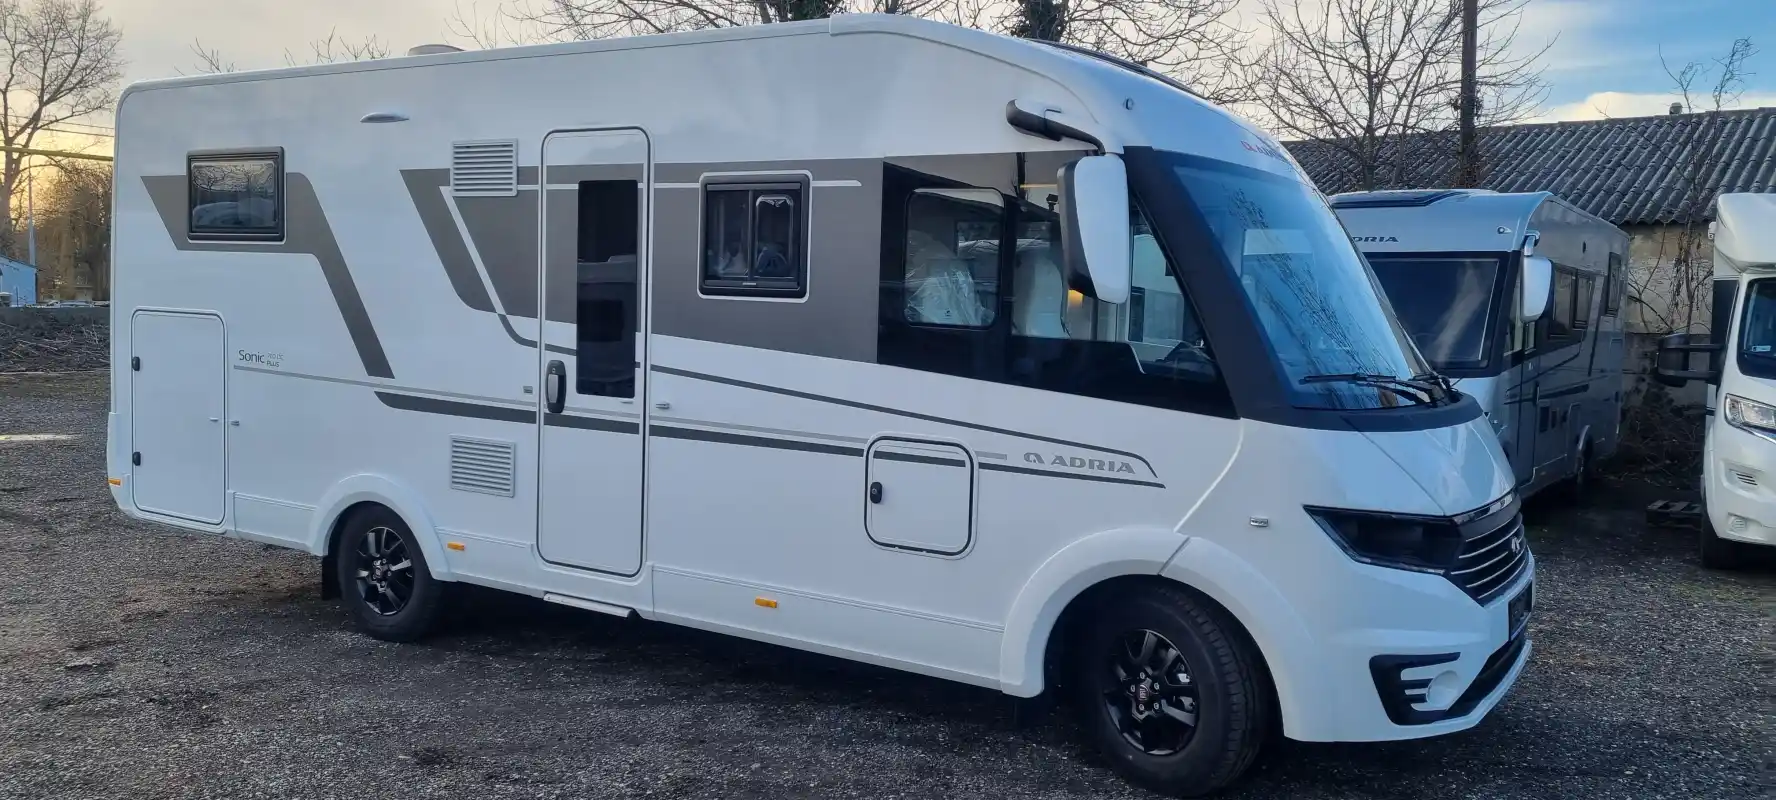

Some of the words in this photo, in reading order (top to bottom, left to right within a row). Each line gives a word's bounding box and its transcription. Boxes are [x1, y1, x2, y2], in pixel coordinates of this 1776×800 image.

[238, 349, 265, 364] Sonic
[266, 360, 280, 368] PLUS
[1050, 454, 1136, 475] ADRIA
